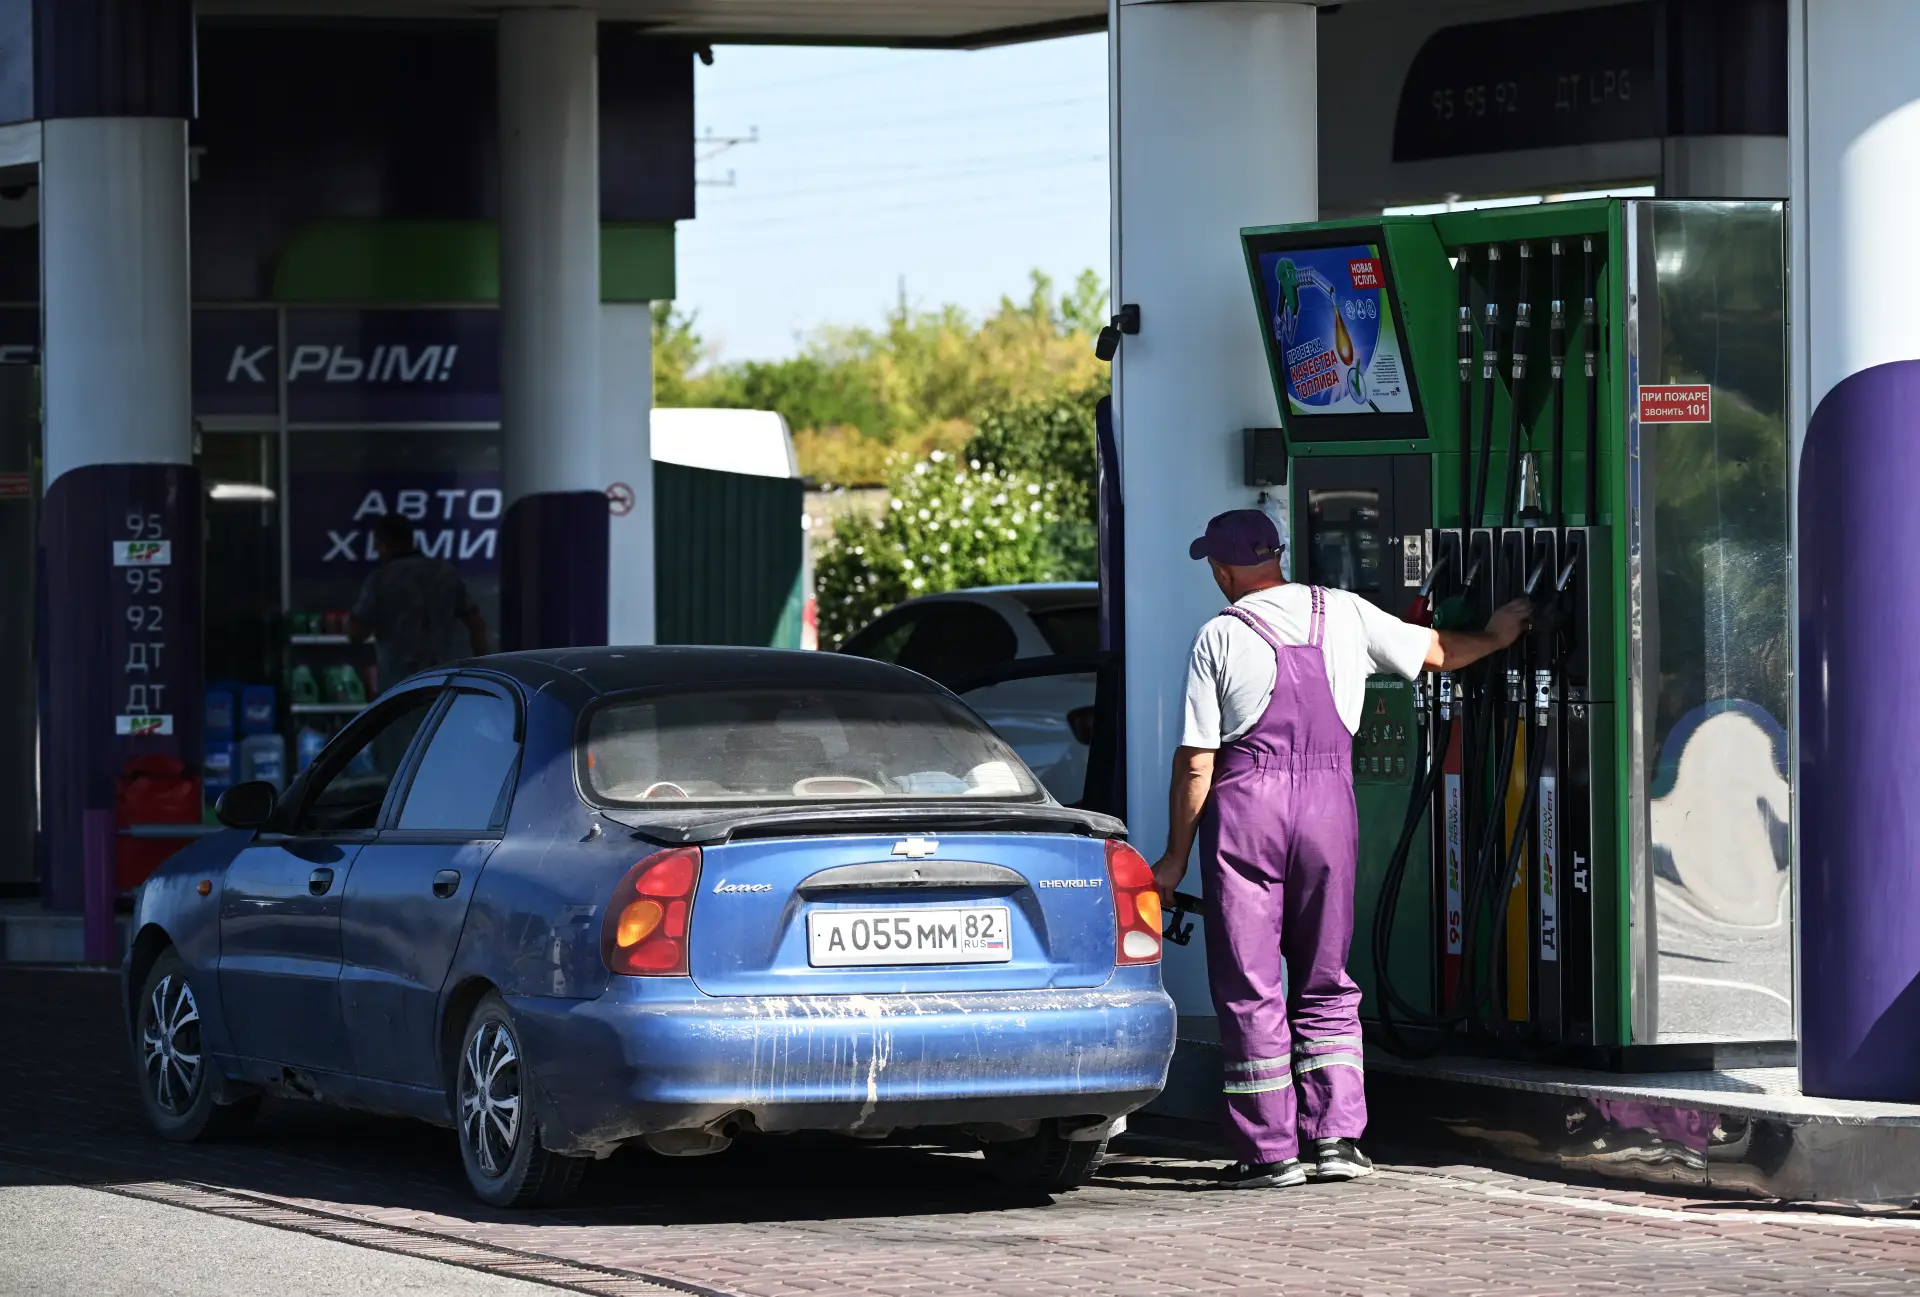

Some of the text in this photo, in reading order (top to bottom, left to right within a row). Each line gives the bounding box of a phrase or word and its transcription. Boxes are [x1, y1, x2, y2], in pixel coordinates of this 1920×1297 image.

[1430, 88, 1454, 121] 95
[1463, 84, 1487, 119] 95
[1554, 73, 1581, 114] ДТ
[1350, 262, 1373, 274] НОВАЯ
[1352, 274, 1378, 286] УСЛУГА
[1286, 337, 1324, 365] ПРОВЕРКА
[1289, 349, 1338, 384] КАЧЕСТВА
[1294, 369, 1340, 401] ТОПЛИВА
[1641, 391, 1708, 402] ПРИ ПОЖАРЕ
[1645, 404, 1706, 416] ЗВОНИТЬ 101
[352, 488, 503, 522] АВТО
[126, 513, 163, 539] 95
[126, 568, 164, 594] 95
[126, 605, 164, 631] 92
[124, 642, 165, 674] ДТ
[125, 684, 165, 715] ДТ
[1038, 879, 1103, 889] CHEVROLET
[1573, 850, 1588, 893] ДТ
[712, 878, 774, 895] Lanos
[965, 914, 995, 939] 82
[1450, 910, 1460, 944] 95
[1542, 909, 1555, 950] ДТ
[964, 939, 987, 949] RUS
